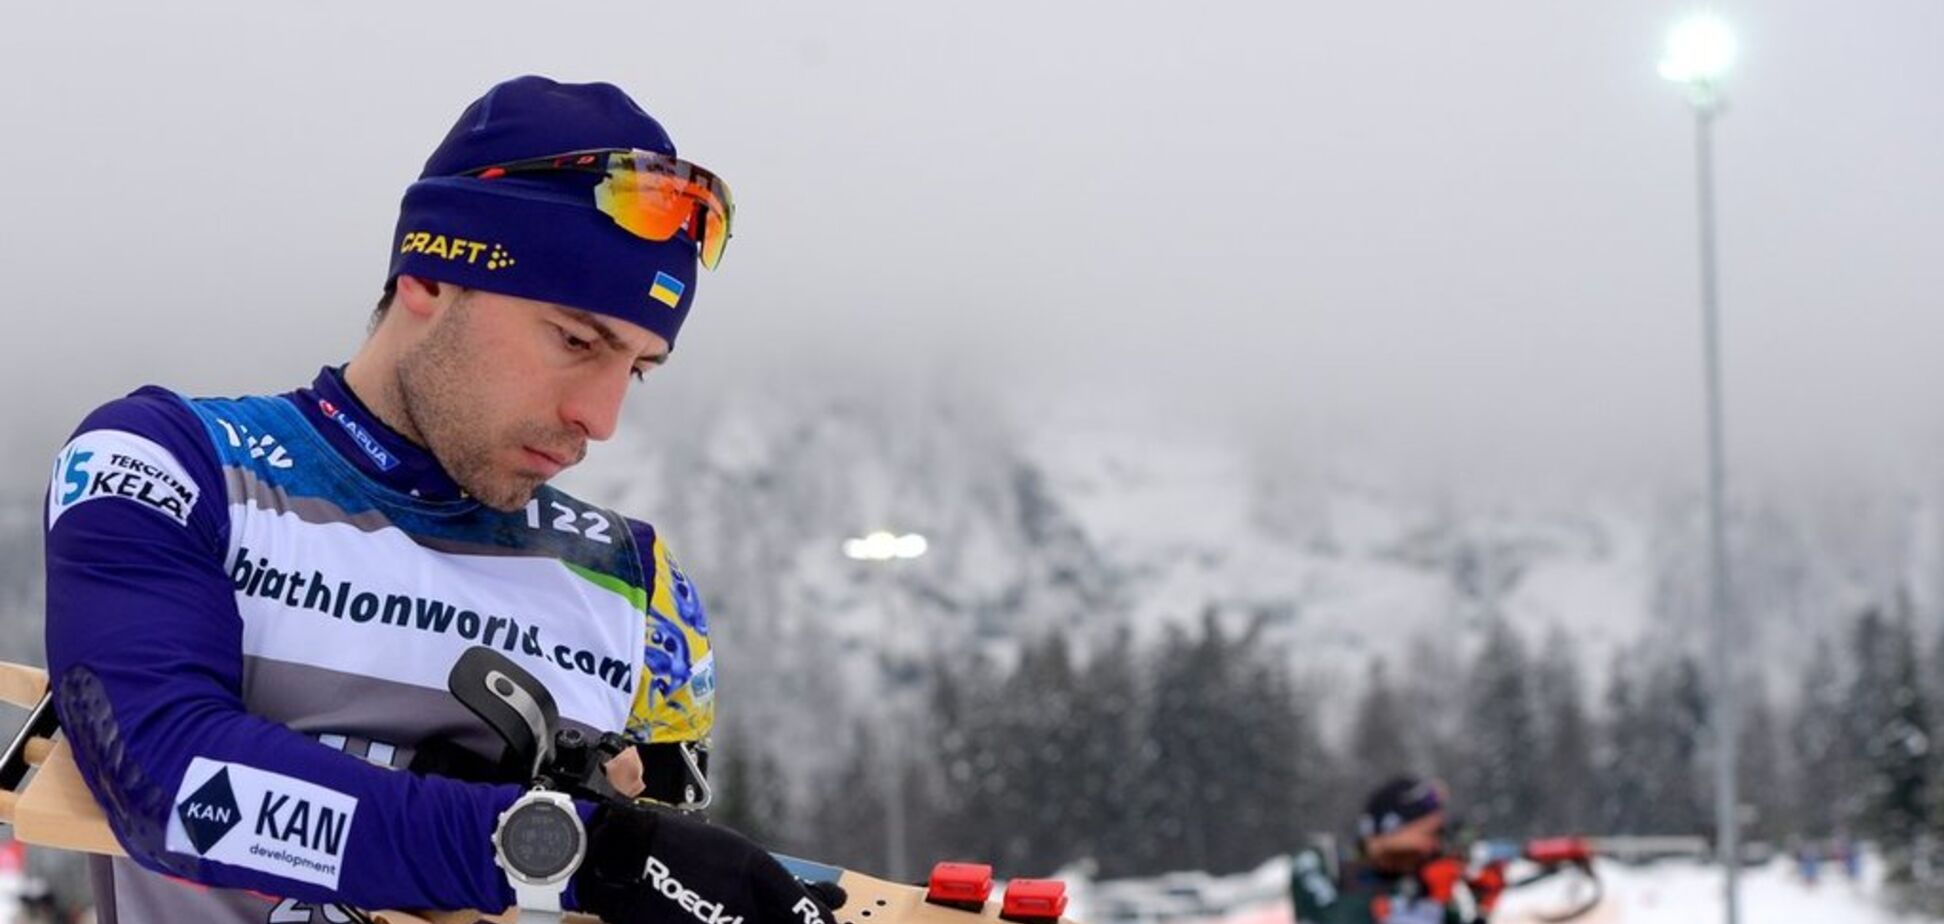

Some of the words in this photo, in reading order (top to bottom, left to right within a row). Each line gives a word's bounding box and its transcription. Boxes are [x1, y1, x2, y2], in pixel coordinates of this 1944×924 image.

[401, 232, 487, 264] CRAFT
[337, 413, 387, 467] LAPUA
[110, 453, 194, 504] TERCIUM
[525, 498, 613, 544] 122
[231, 547, 632, 693] biathlonworld.com
[187, 802, 231, 824] KAN
[254, 790, 348, 857] KAN
[249, 843, 336, 876] development
